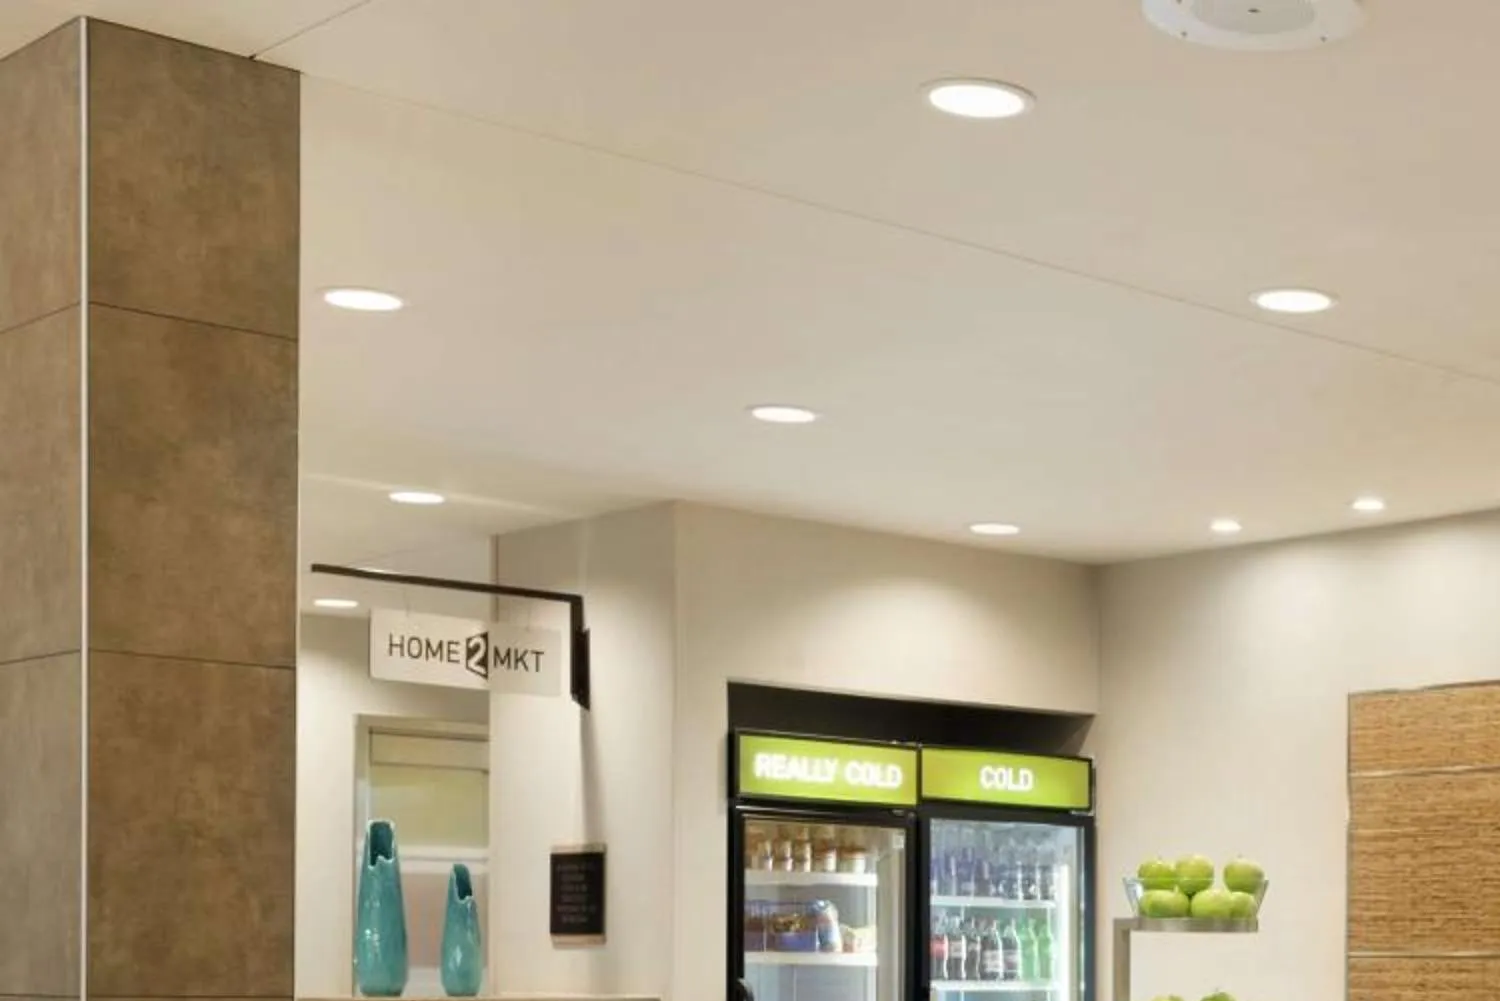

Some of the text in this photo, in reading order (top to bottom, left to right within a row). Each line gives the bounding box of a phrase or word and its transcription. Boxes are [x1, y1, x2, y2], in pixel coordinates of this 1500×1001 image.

[493, 645, 544, 673] MKT
[754, 752, 903, 789] REALLY COLD
[980, 765, 1033, 791] COLD
